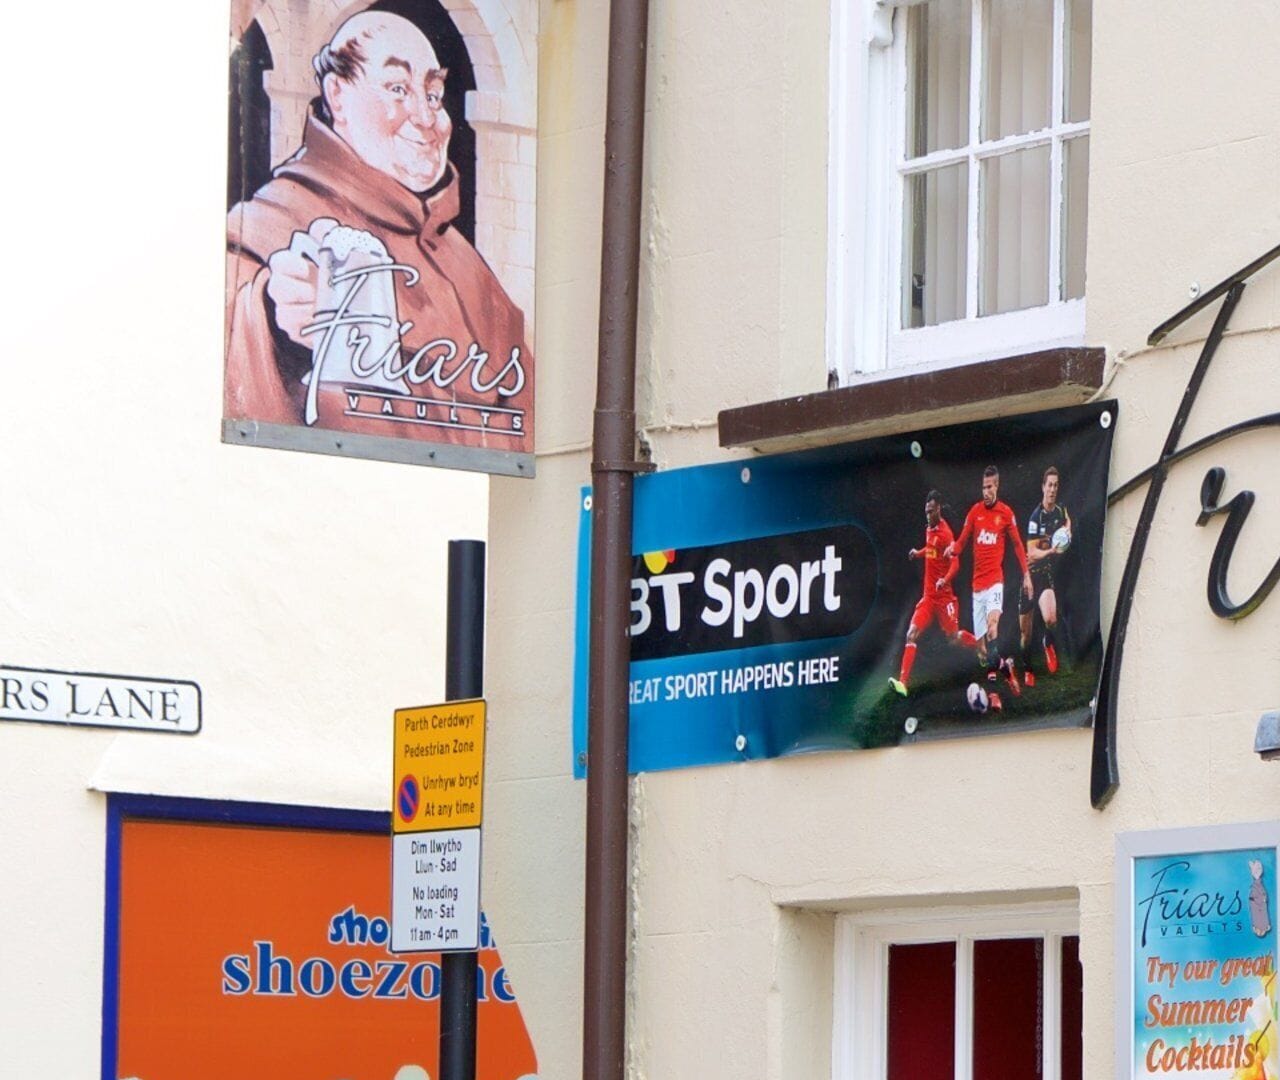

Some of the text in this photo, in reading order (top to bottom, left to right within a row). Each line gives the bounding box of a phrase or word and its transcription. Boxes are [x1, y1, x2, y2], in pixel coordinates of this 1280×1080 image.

[300, 262, 527, 426] Friars
[346, 395, 524, 431] VAULTS
[628, 545, 843, 639] BT Sport
[629, 656, 840, 704] REAT SPORT HAPPENS HERE
[70, 683, 182, 723] LANE
[404, 712, 474, 732] Parth Cerddwyr
[404, 739, 474, 759] Pedestrian Zone
[422, 772, 479, 791] Unrhyw bryd
[424, 799, 475, 818] At any time
[411, 838, 462, 855] Dim llwytho
[415, 857, 457, 874] Llun Sad
[412, 883, 458, 901] No loading
[1138, 861, 1244, 948] Friars
[415, 904, 455, 920] Mon Sat
[1160, 922, 1244, 937] VAULTS
[222, 942, 516, 1002] shoezoe
[1146, 952, 1274, 989] Try our great
[1144, 994, 1254, 1028] Summer
[1145, 1034, 1257, 1073] Cocktails
